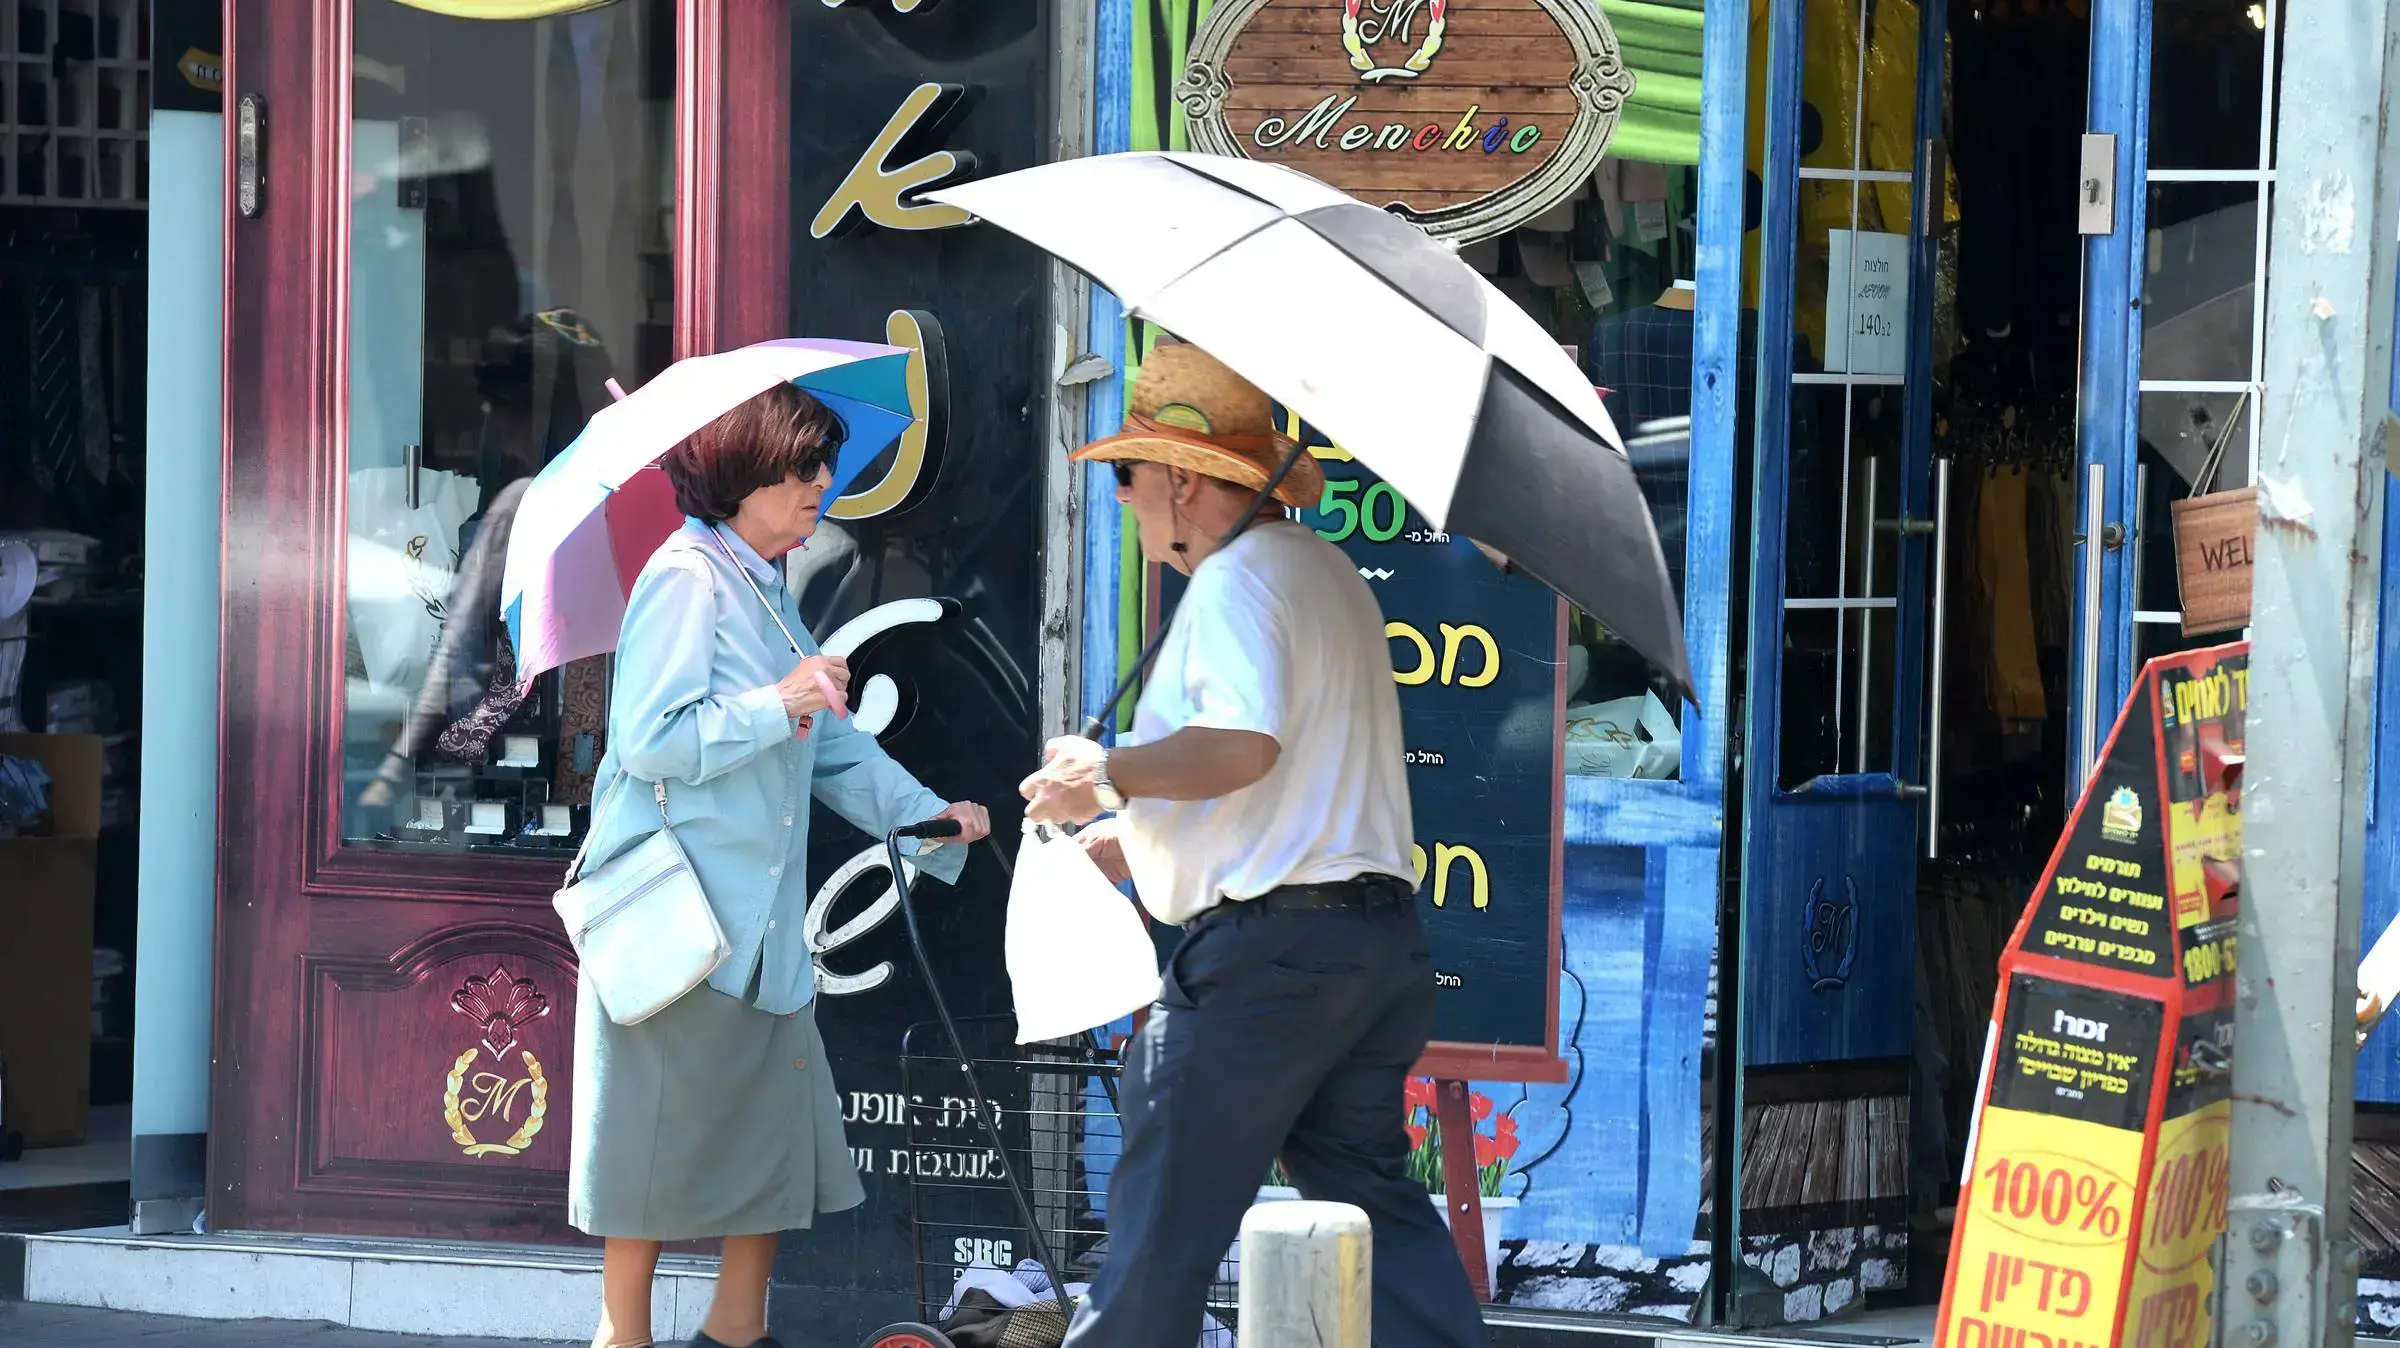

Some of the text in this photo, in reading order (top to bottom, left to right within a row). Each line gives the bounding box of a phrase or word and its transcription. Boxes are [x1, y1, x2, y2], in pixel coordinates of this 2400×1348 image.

[1253, 94, 1542, 153] Menchic
[1863, 257, 1889, 273] חולצות
[1315, 479, 1406, 542] 50
[2200, 536, 2254, 572] WEL
[1417, 750, 1444, 765] החל
[2086, 854, 2142, 879] תורמים
[2060, 905, 2149, 936] נשים וילדים
[2044, 930, 2156, 965] מכפרים ערביים
[1435, 971, 1462, 987] החל
[2052, 1008, 2110, 1042] זכור!
[460, 1071, 533, 1122] M
[1984, 1158, 2120, 1237] 100%
[1979, 1252, 2092, 1318] פדיון
